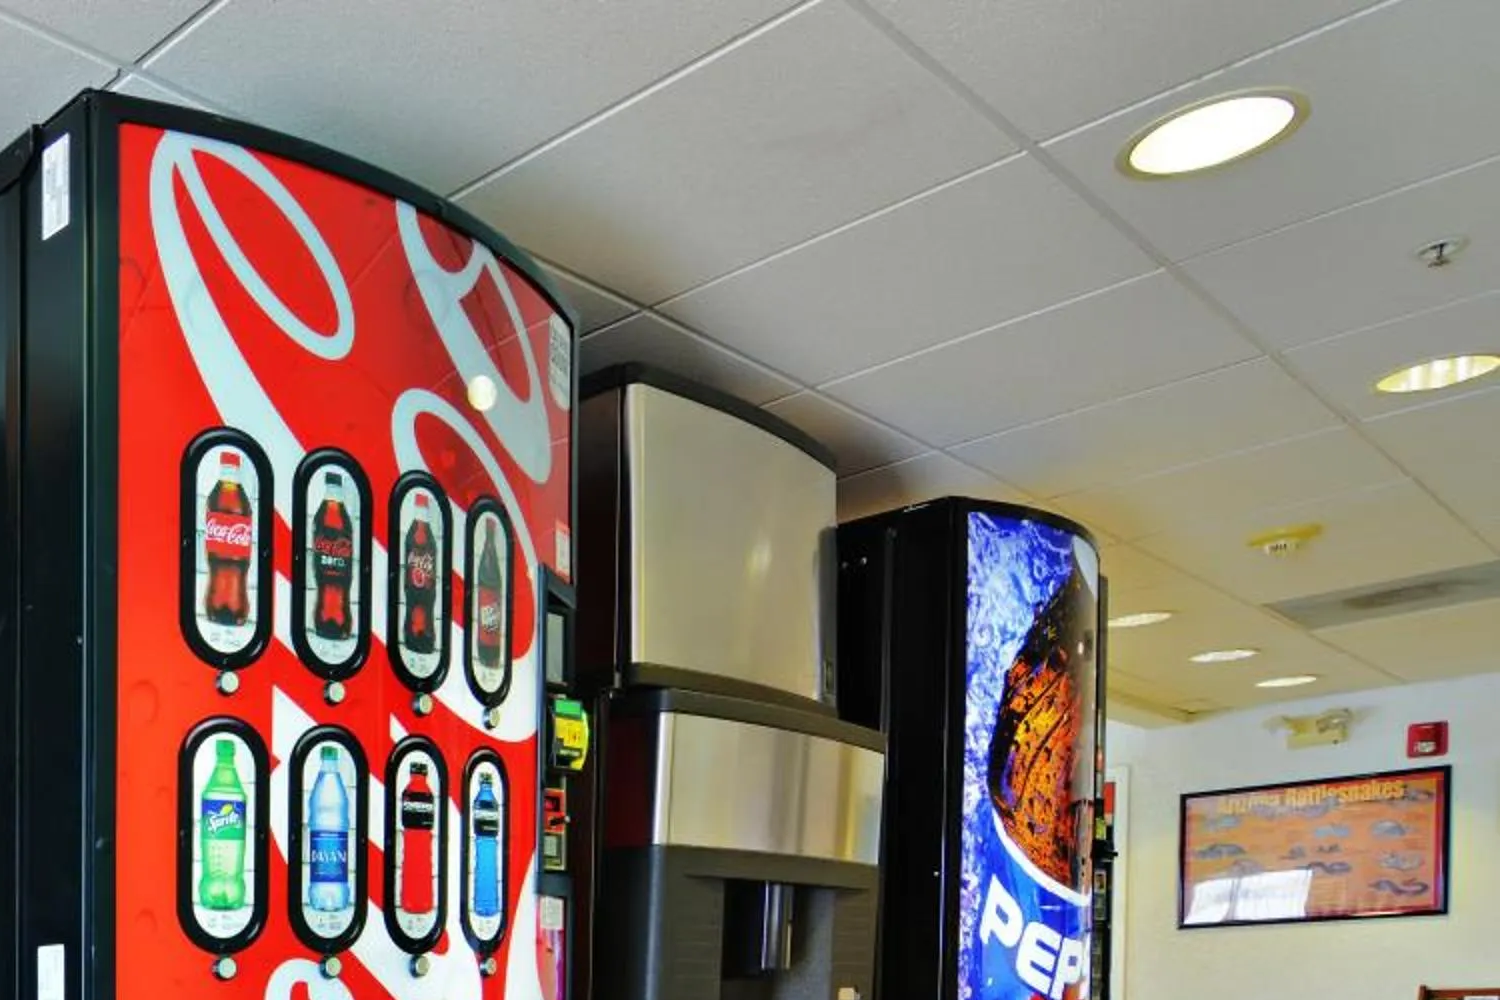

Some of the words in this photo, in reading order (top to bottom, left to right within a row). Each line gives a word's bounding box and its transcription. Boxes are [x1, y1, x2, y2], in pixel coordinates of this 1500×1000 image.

[206, 518, 251, 547] Coca-Cola
[1286, 779, 1404, 807] Rattlesnakes
[209, 812, 240, 833] Sprite
